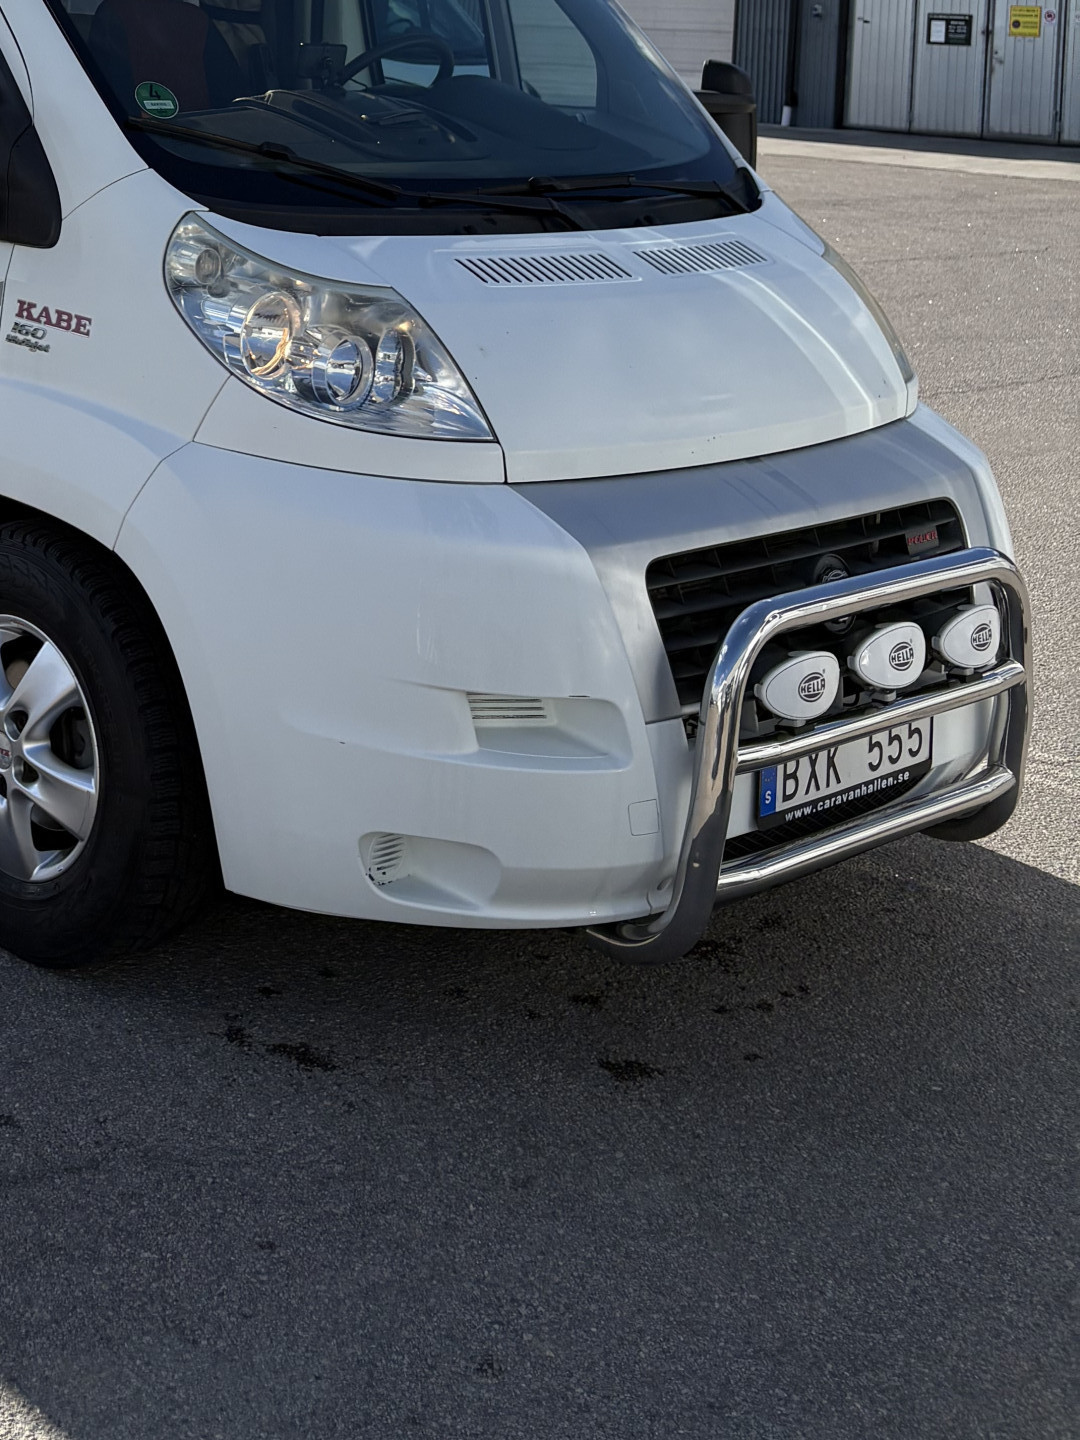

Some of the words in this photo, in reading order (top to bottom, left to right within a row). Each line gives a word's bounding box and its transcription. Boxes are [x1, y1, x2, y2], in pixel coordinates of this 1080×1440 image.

[15, 299, 93, 338] KABE
[972, 628, 993, 645] HELLA
[890, 647, 915, 664] HELLA
[800, 677, 826, 695] HELLA
[782, 746, 842, 803] BXK
[868, 722, 923, 772] 555
[765, 790, 772, 805] S
[785, 770, 911, 822] www.caravanhallen.se
